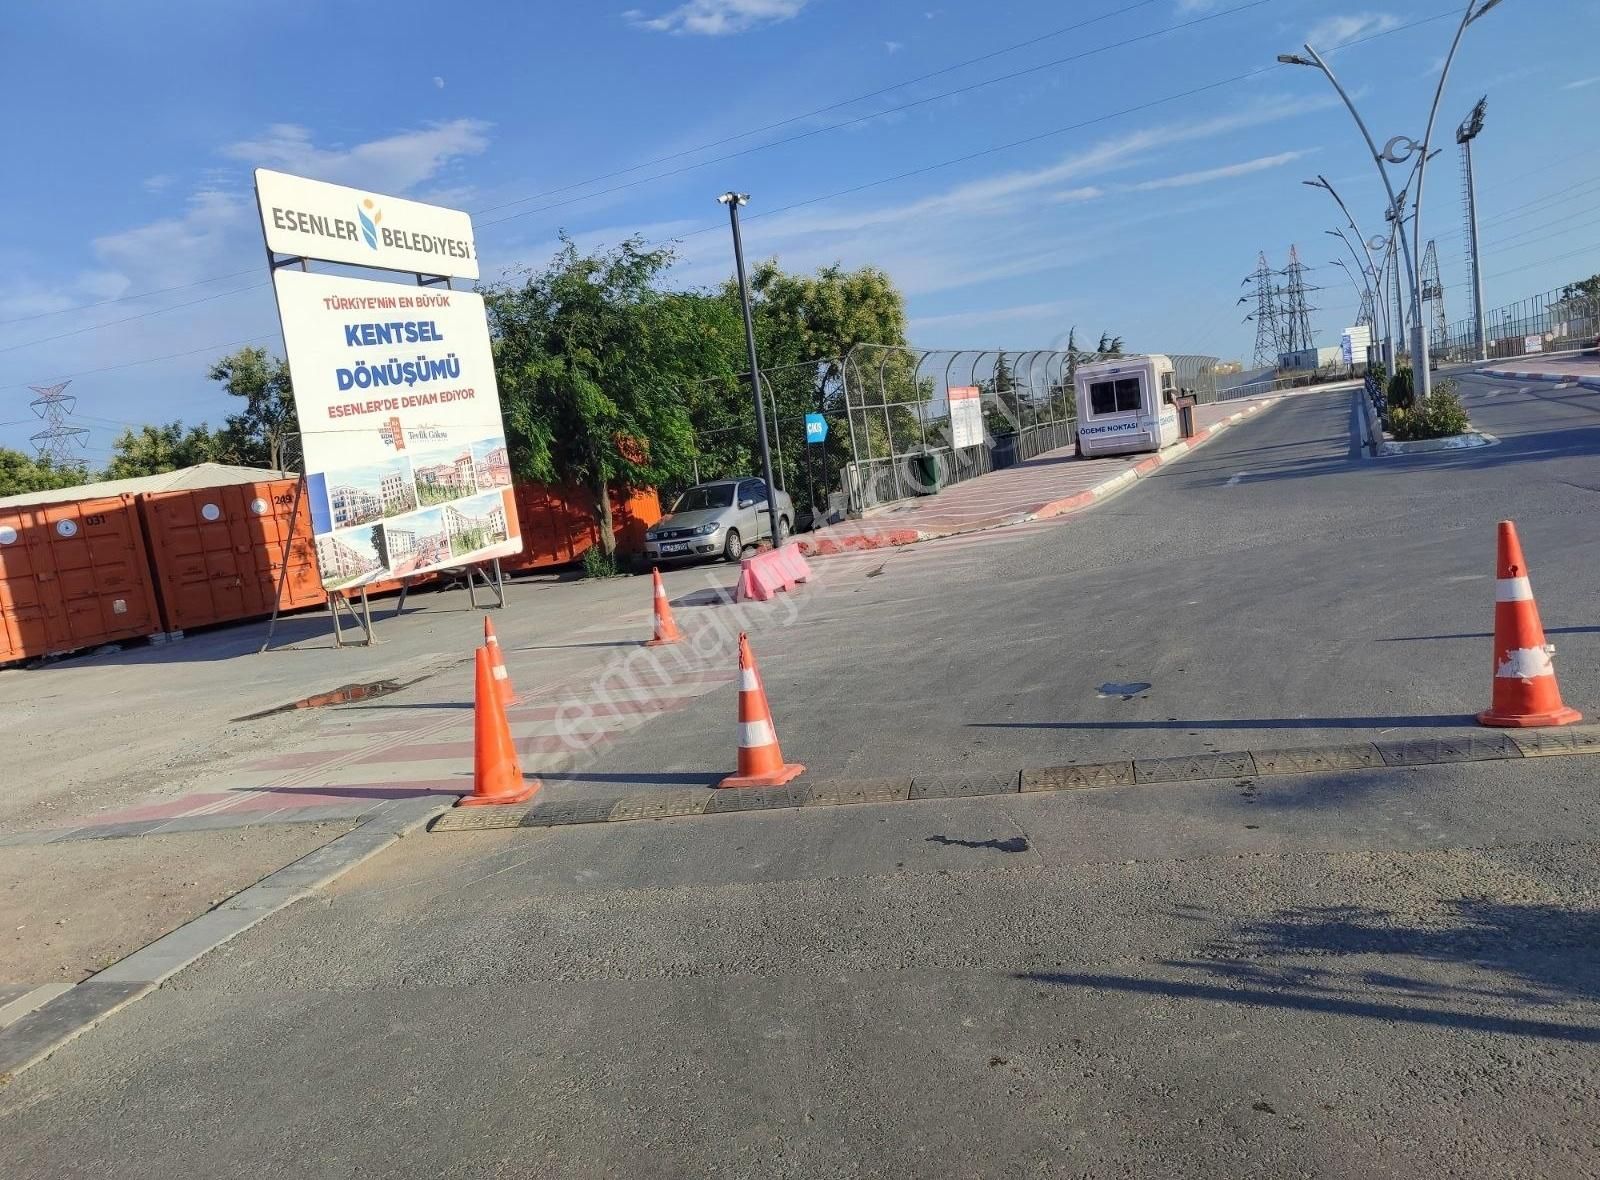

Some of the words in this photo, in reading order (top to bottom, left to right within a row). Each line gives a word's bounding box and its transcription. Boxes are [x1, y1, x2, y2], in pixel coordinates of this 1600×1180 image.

[272, 207, 359, 242] ESENLER
[399, 299, 414, 308] EN
[416, 294, 450, 308] BÜYÜK
[344, 320, 443, 347] KENTSEL
[336, 353, 460, 391] DÖNÜŞÜMÜ
[328, 399, 399, 418] ESENLER'DE
[402, 393, 438, 408] DEVAM
[1080, 427, 1106, 435] ÖDEME
[1107, 422, 1138, 432] NOKTASI
